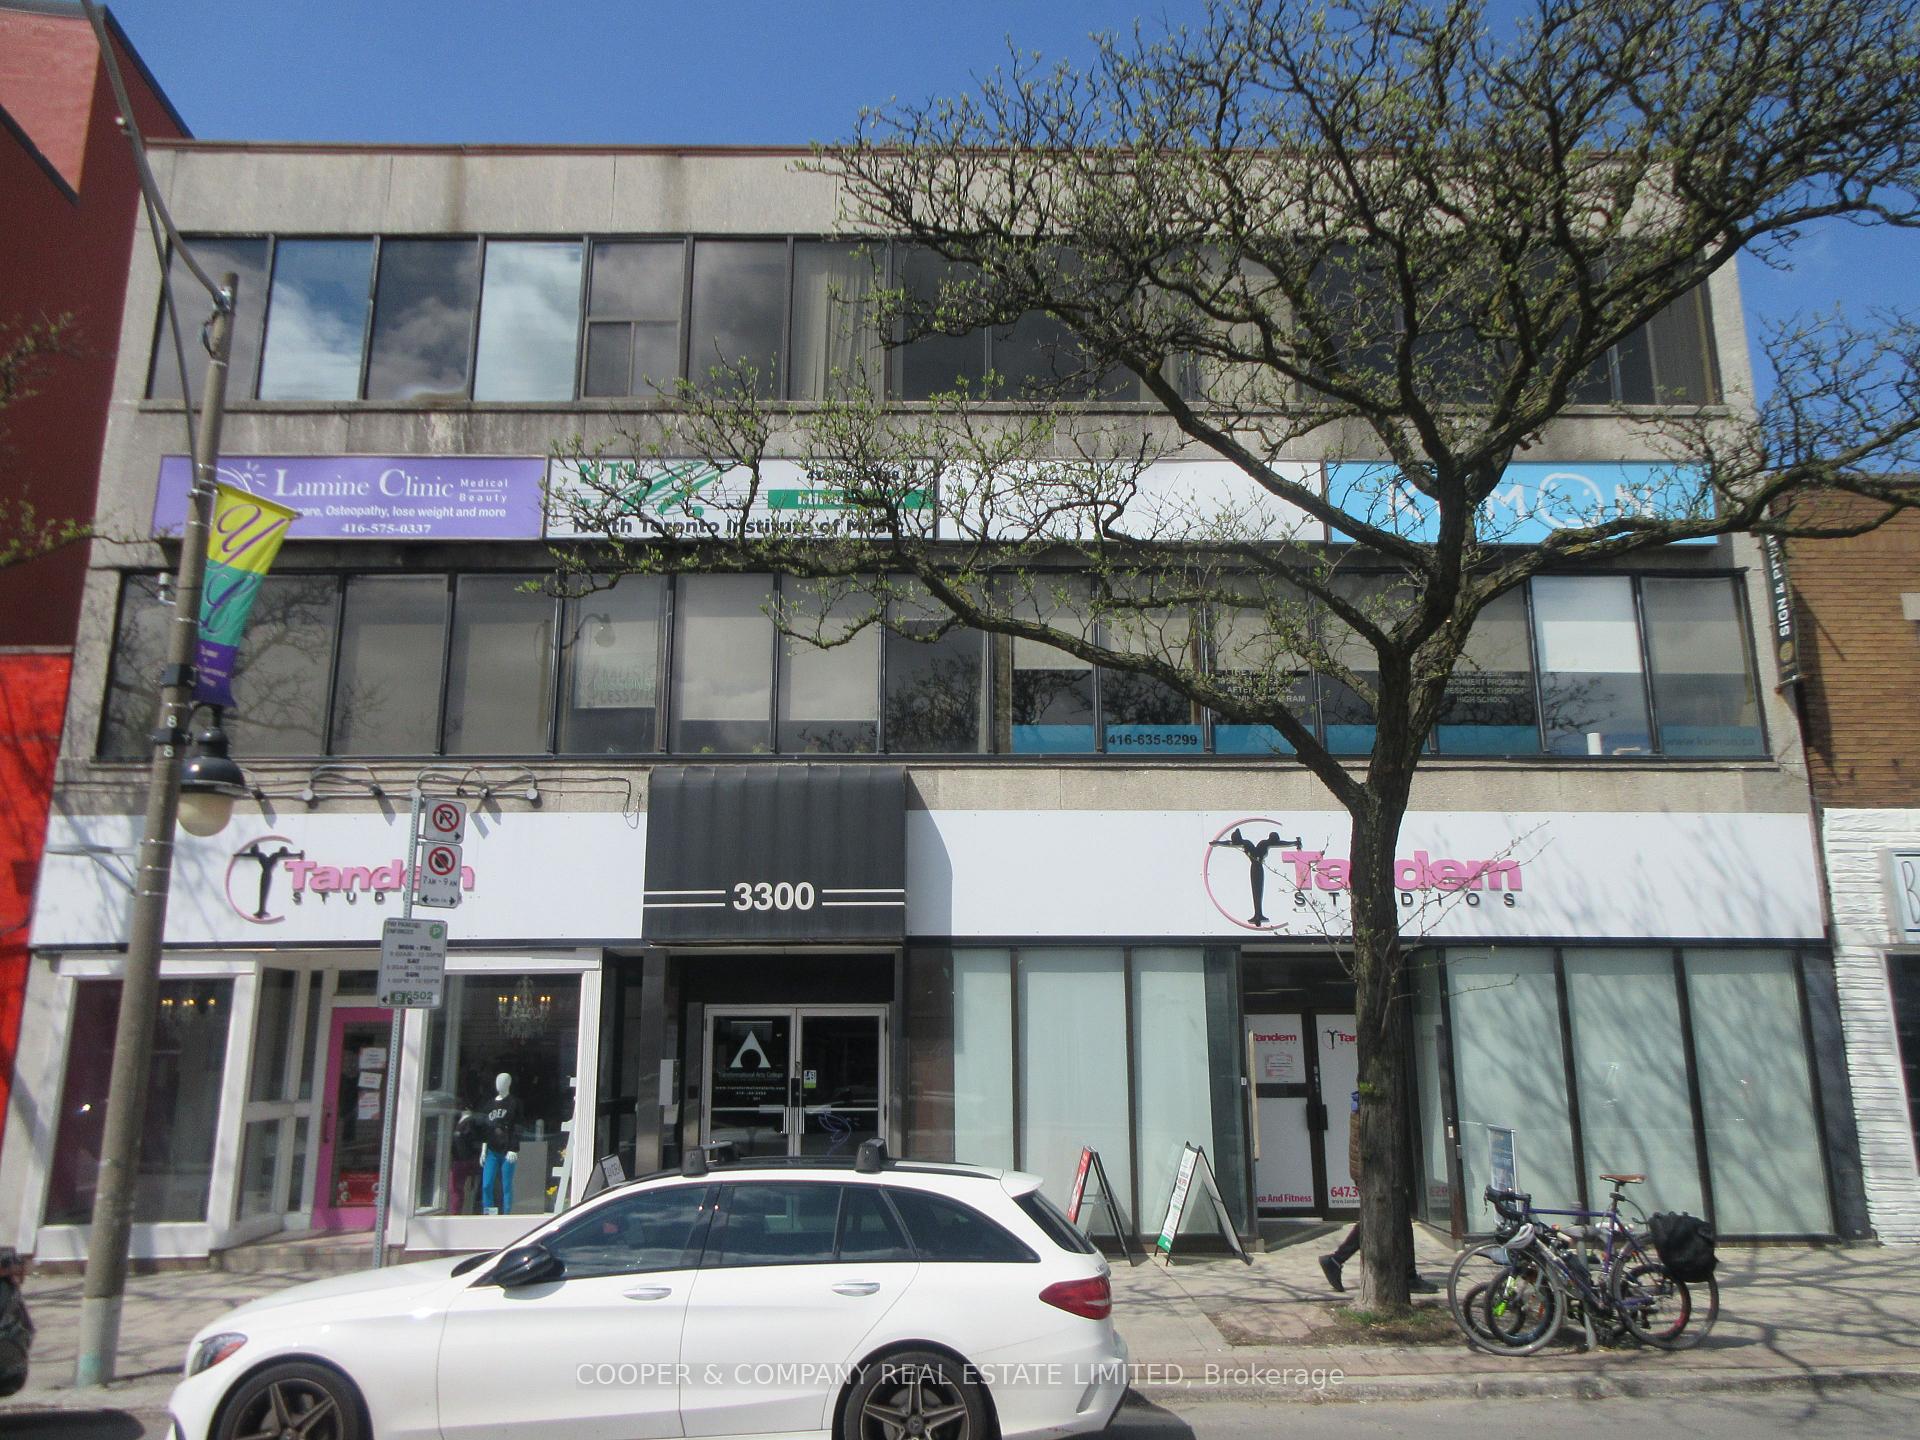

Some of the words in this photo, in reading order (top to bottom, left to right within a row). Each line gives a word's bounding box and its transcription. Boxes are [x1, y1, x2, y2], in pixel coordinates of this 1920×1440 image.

[275, 468, 370, 497] Lumine
[379, 468, 454, 497] Clinic
[460, 479, 508, 488] Medical
[459, 493, 507, 503] Beauty
[1387, 473, 1653, 529] KMON
[297, 508, 322, 518] are,
[326, 505, 391, 518] Osteopathy,
[392, 506, 415, 517] lose
[418, 506, 453, 519] weight
[456, 507, 477, 518] and
[479, 508, 506, 518] more
[342, 523, 432, 534] 416-575-0337
[574, 518, 632, 534] Nth
[1776, 597, 1791, 637] SIGN
[1444, 687, 1485, 695] RESCHOOL
[1108, 734, 1198, 746] 416-635-8299
[284, 859, 475, 893] Tand
[1282, 850, 1523, 892] Tadem
[733, 882, 815, 911] 3300
[1294, 892, 1516, 906] STDIOS
[1268, 1194, 1283, 1203] And
[1284, 1194, 1312, 1203] Fitness
